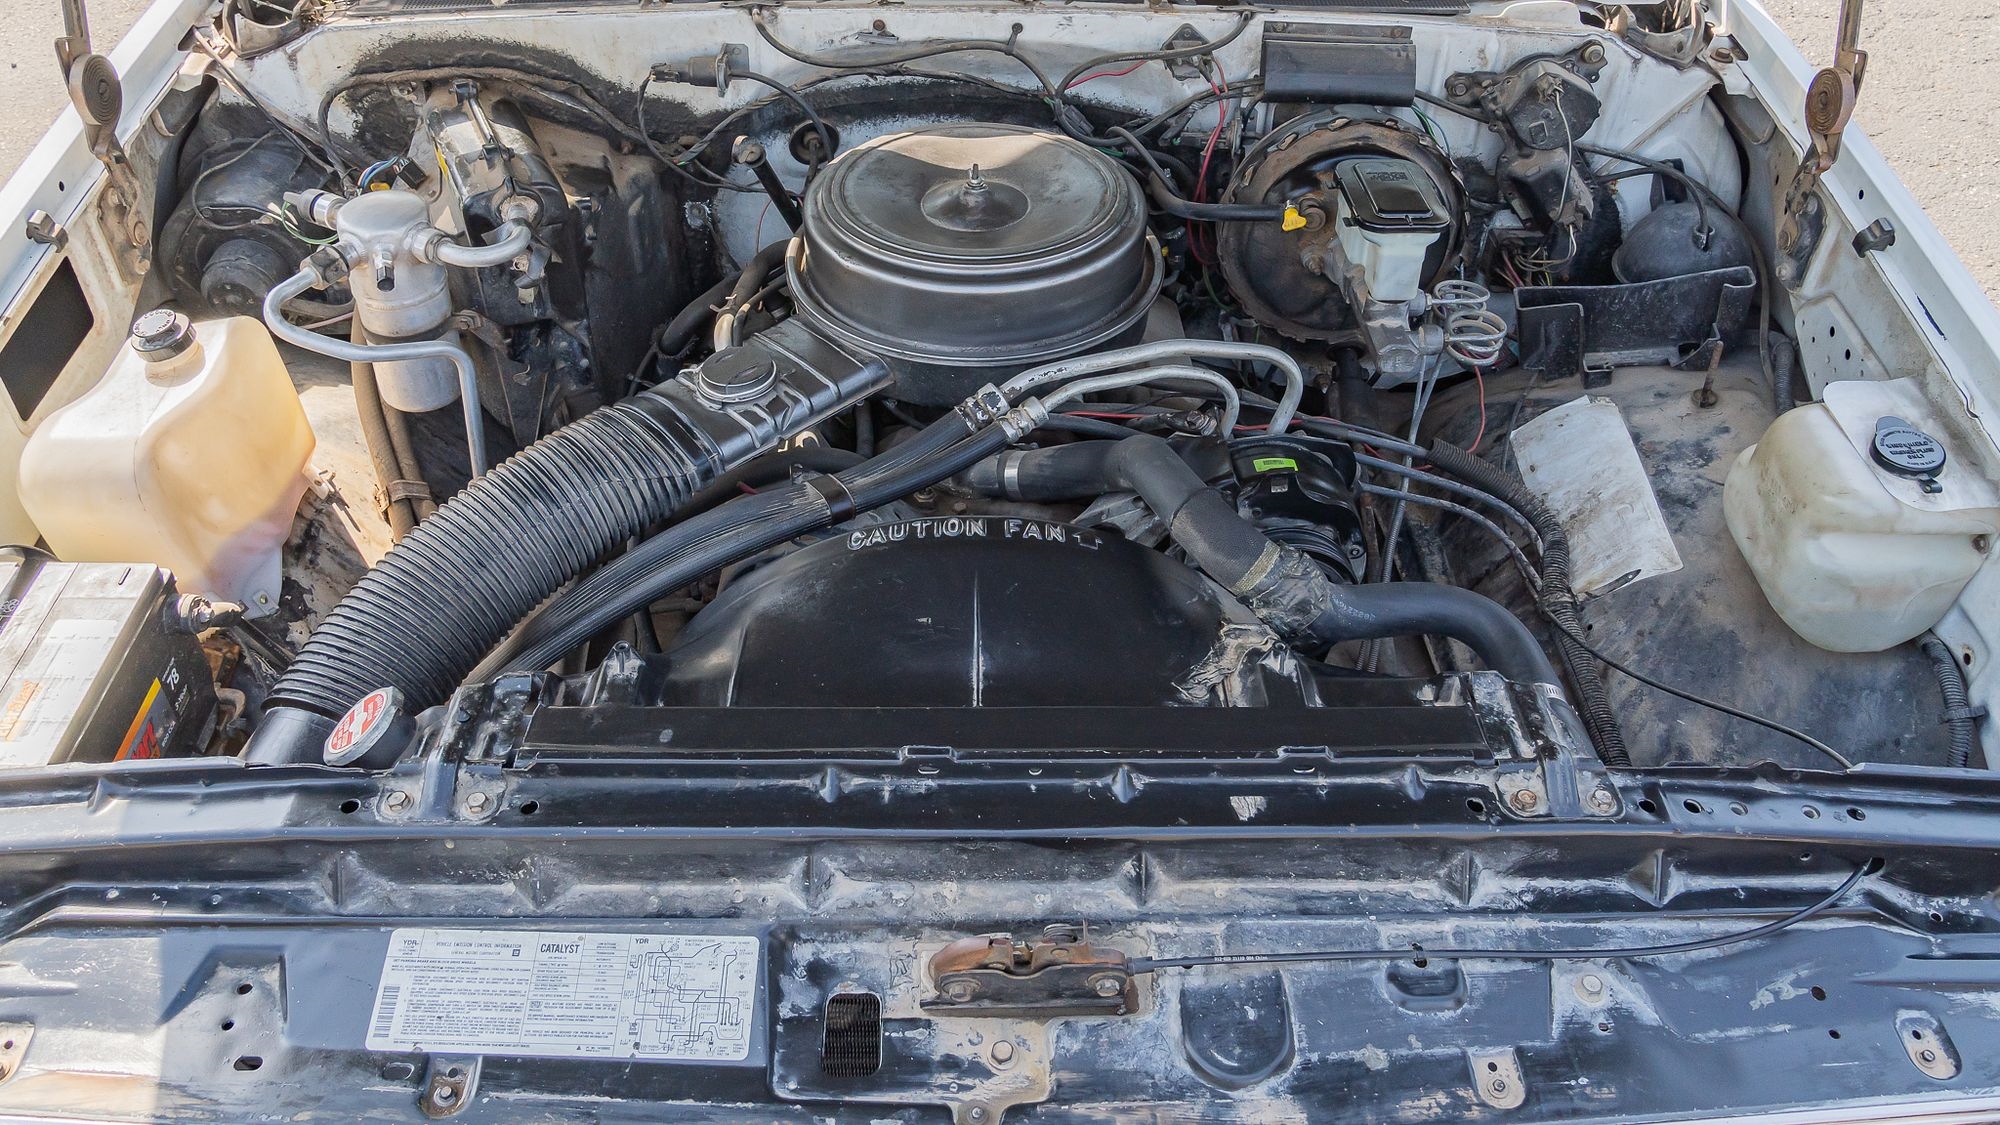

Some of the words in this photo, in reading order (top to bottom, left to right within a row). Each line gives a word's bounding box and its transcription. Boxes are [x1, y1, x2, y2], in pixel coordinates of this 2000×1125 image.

[847, 518, 988, 551] CAUTION
[1004, 518, 1066, 543] FAN
[166, 667, 180, 691] 78
[540, 943, 580, 954] CATALYST
